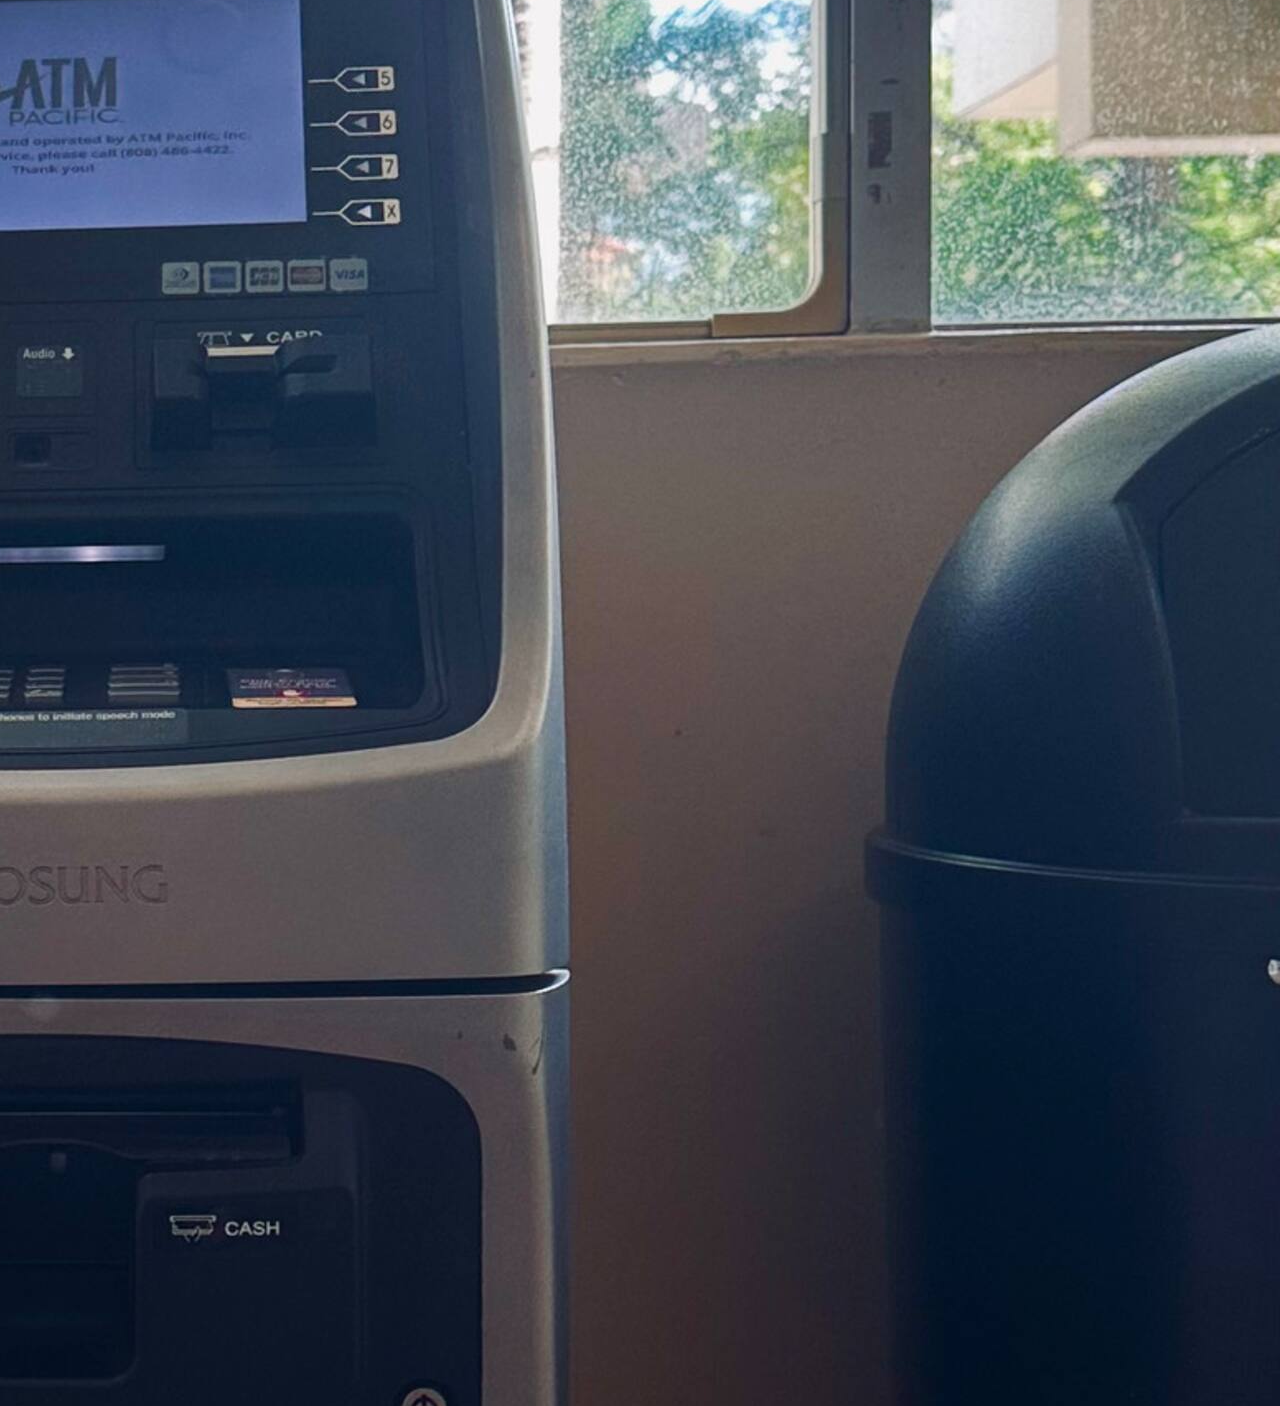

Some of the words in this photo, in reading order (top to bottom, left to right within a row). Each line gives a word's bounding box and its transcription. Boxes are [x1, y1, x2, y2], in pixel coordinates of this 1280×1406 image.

[11, 57, 117, 110] ATM
[380, 71, 390, 85] 5
[9, 108, 119, 126] PACIFIC
[382, 114, 393, 130] 6
[0, 136, 29, 146] and
[33, 135, 102, 147] operated
[106, 134, 123, 145] by
[127, 133, 161, 143] ATM
[38, 150, 87, 162] please
[91, 148, 117, 159] call
[11, 165, 61, 174] Thank
[63, 164, 94, 176] you!
[384, 158, 394, 173] 7
[336, 268, 364, 281] VISA
[23, 348, 56, 360] Audio
[38, 712, 49, 721] to
[52, 711, 93, 721] initiate
[96, 710, 138, 721] speech
[142, 709, 176, 719] mode
[224, 1220, 281, 1236] CASH
